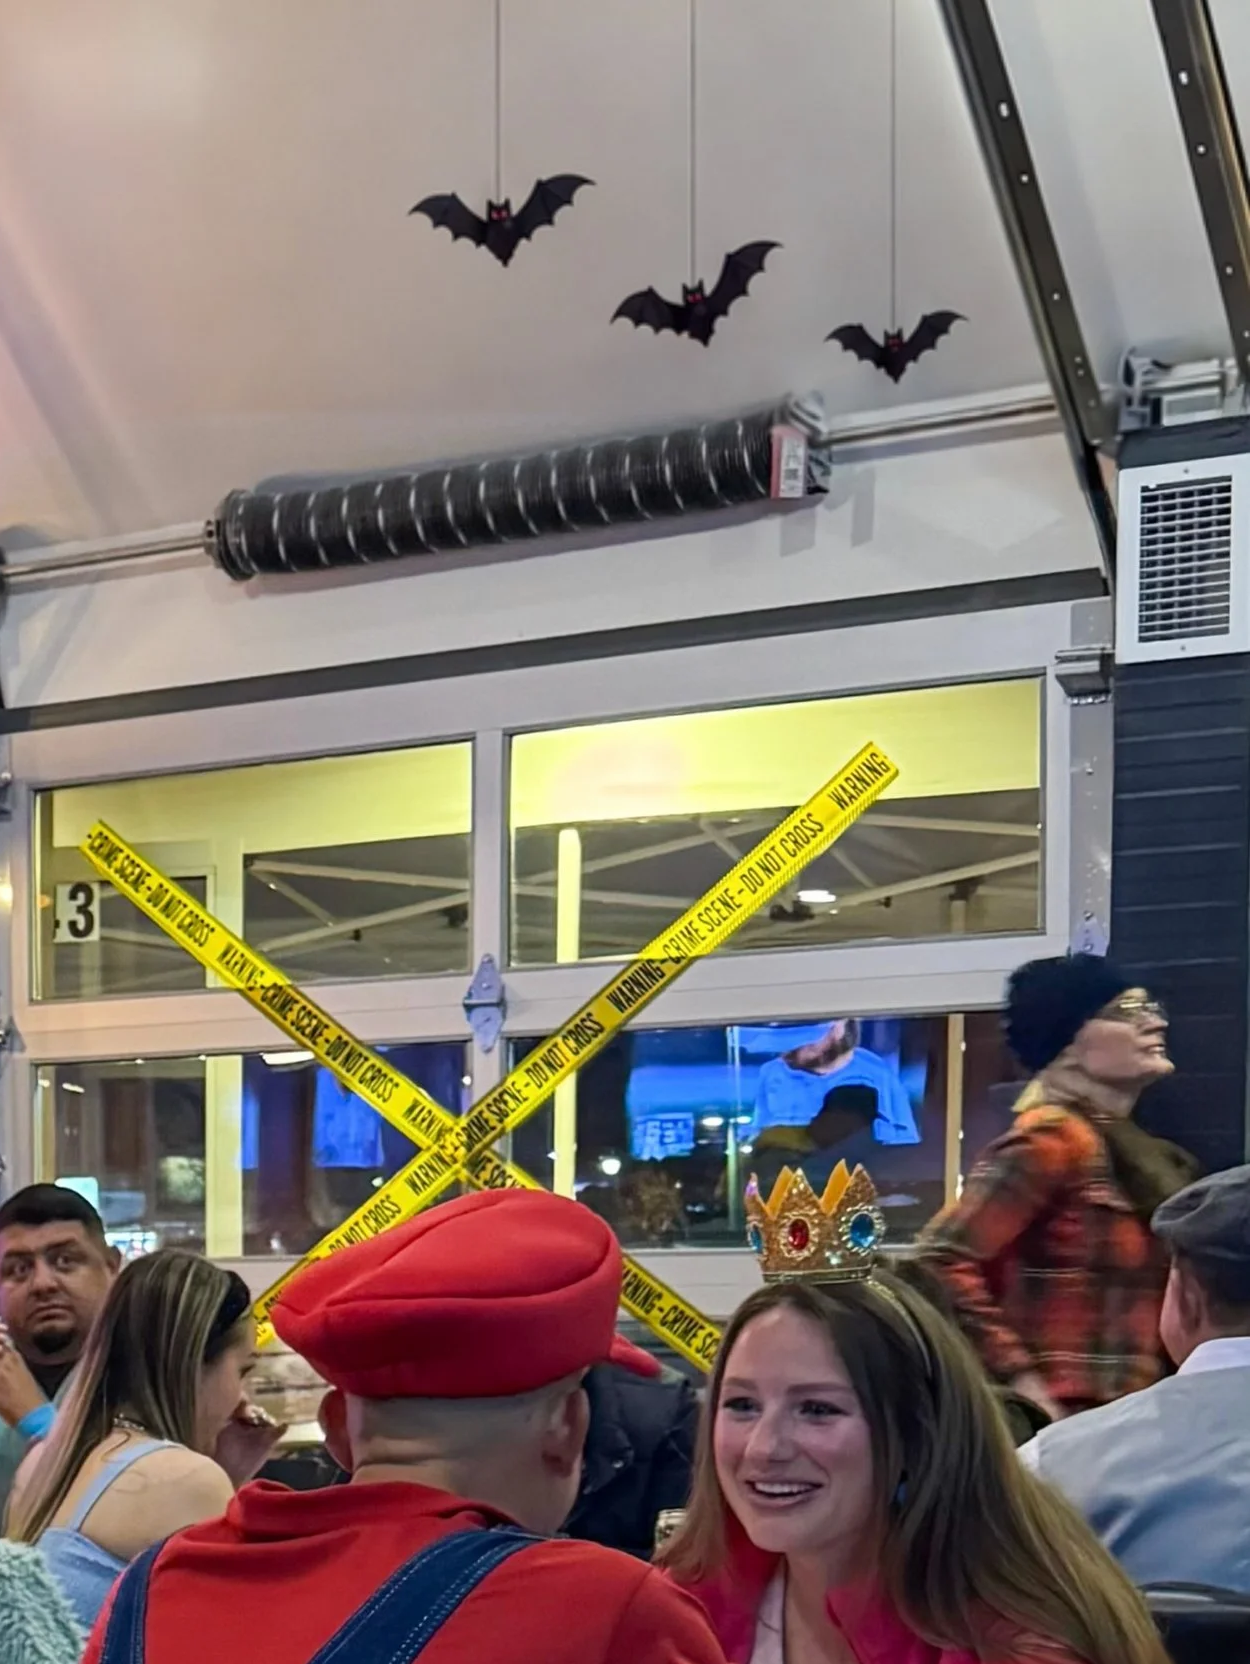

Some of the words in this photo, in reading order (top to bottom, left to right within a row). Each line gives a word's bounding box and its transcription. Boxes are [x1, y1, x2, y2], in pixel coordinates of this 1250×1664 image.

[113, 854, 152, 893] SCENE
[145, 882, 169, 908] DO
[157, 891, 188, 922] NOT
[176, 909, 215, 947] CROSS
[216, 940, 265, 991] WARNING
[261, 982, 300, 1020] CRIME
[291, 1004, 330, 1046] SCENE
[325, 1034, 350, 1062] DO
[338, 1044, 370, 1077] NOT
[358, 1063, 400, 1103] CROSS
[362, 1194, 401, 1235] CROSS
[455, 1110, 497, 1153] CRIME
[486, 1081, 529, 1124] SCENE
[524, 1061, 549, 1089] DO
[540, 1042, 570, 1076] NOT
[561, 1012, 605, 1056] CROSS
[606, 958, 666, 1014] WARNING
[662, 920, 707, 964] CRIME
[697, 887, 743, 933] SCENE
[740, 866, 764, 894] DO
[755, 845, 787, 880] NOT
[779, 812, 824, 858] CROSS
[827, 752, 890, 811] WARNING
[621, 1265, 664, 1316] ARNING
[659, 1304, 705, 1347] CRIME
